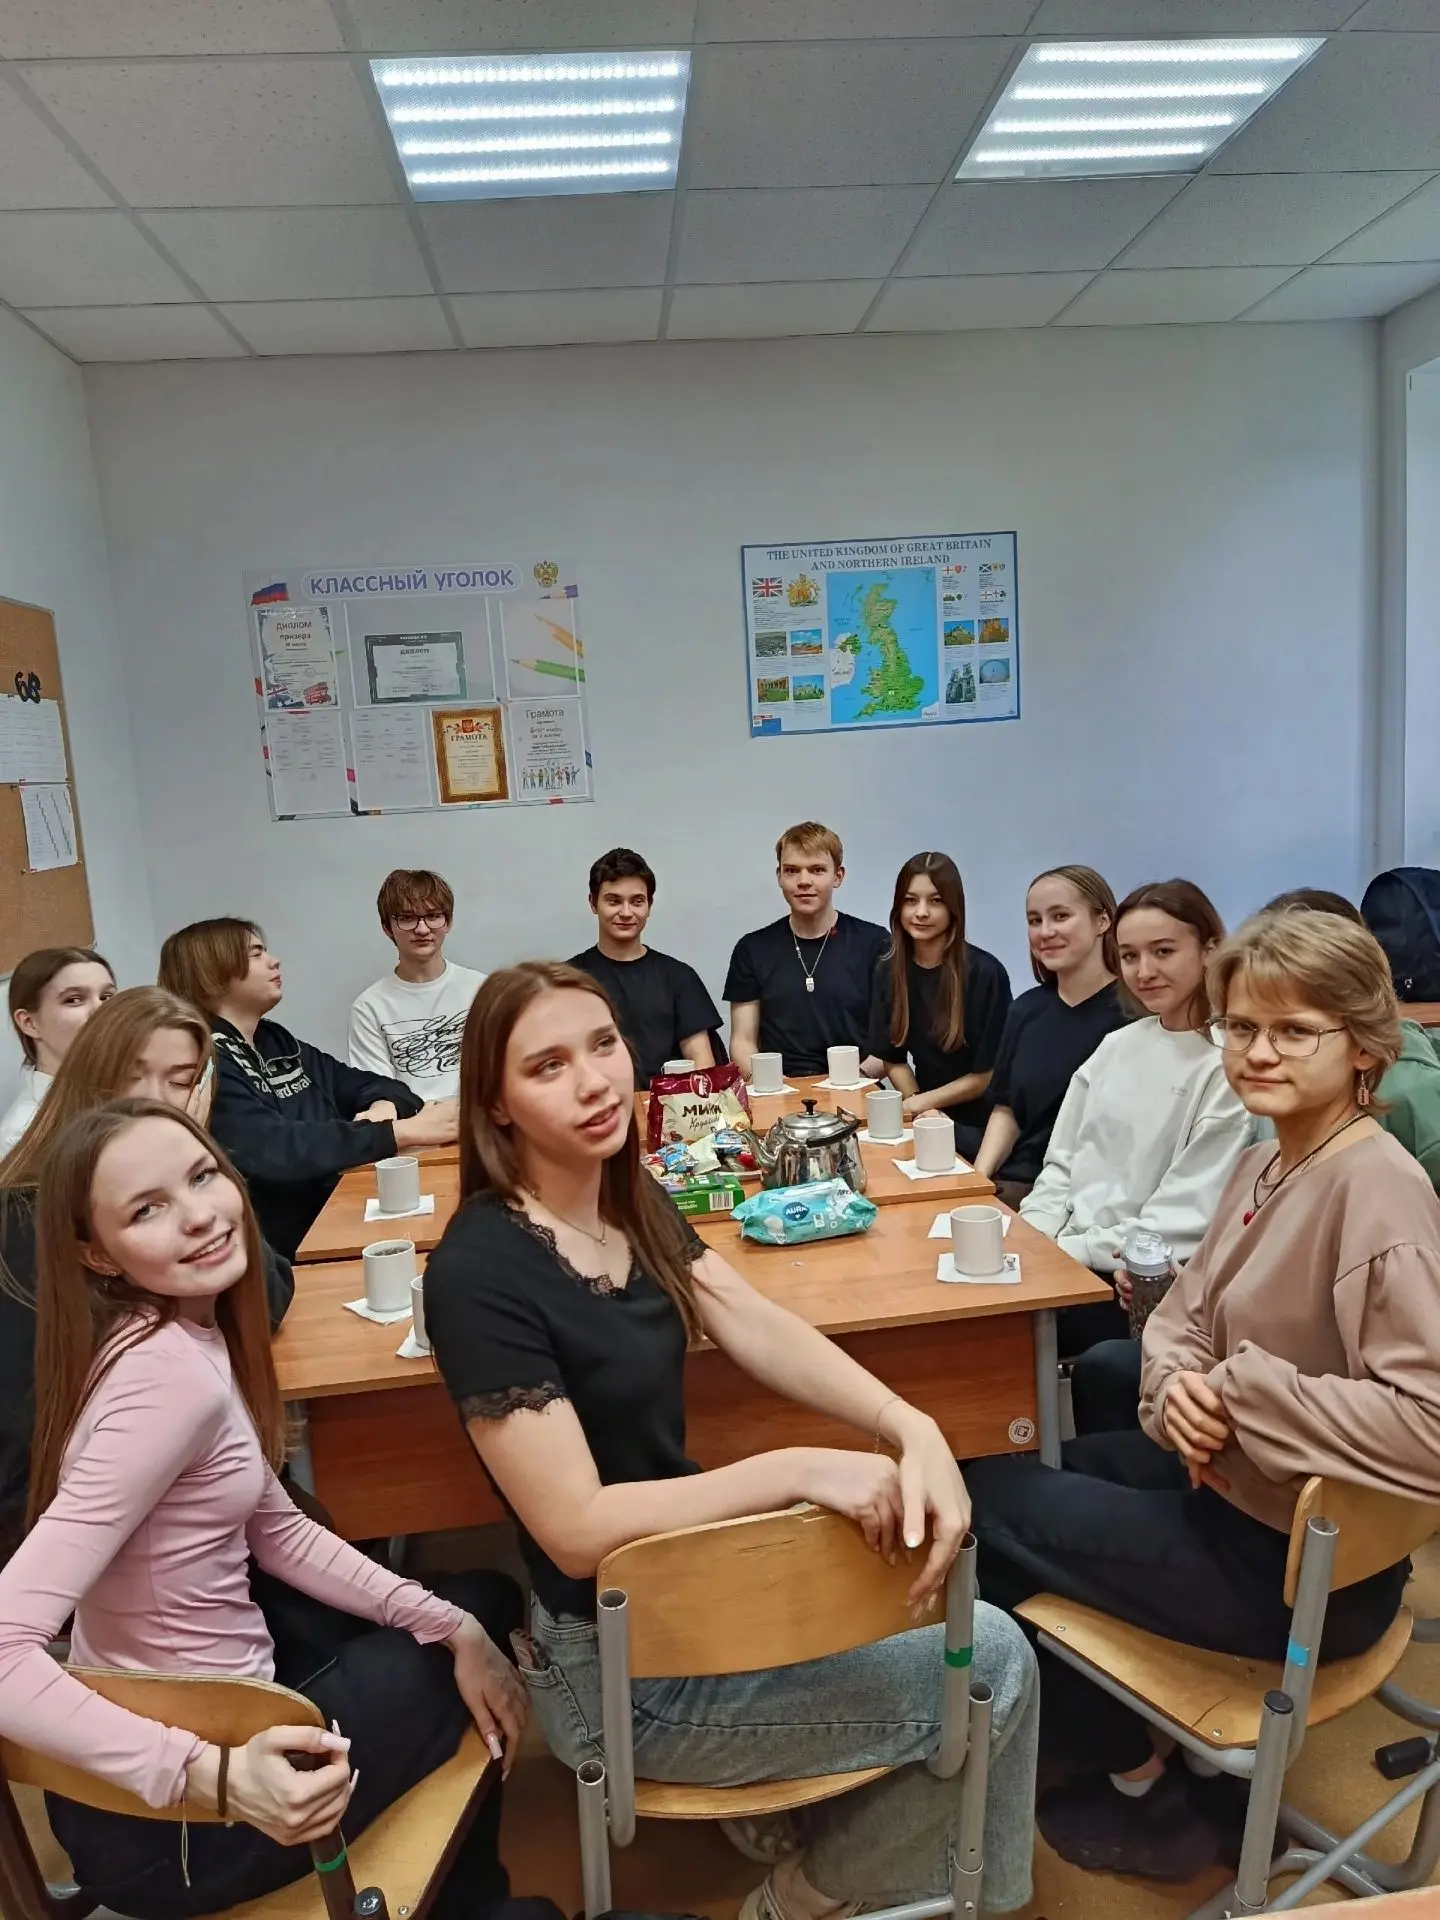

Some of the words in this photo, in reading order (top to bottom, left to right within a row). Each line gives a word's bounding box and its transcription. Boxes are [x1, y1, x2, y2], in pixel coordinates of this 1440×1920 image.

[767, 550, 788, 561] THE
[792, 548, 833, 559] UNITED
[835, 544, 888, 557] KINGDOM
[890, 543, 906, 555] OF
[906, 541, 943, 553] GREAT
[946, 538, 992, 552] BRITAIN
[811, 559, 835, 571] AND
[837, 557, 899, 570] NORTHERN
[901, 554, 950, 566] IRELAND
[310, 569, 428, 595] КЛАССНЫЙ
[433, 569, 515, 592] УГОЛОК
[525, 705, 565, 719] Грамота
[450, 733, 488, 742] ГРАМОТА
[785, 1205, 809, 1216] AURA
